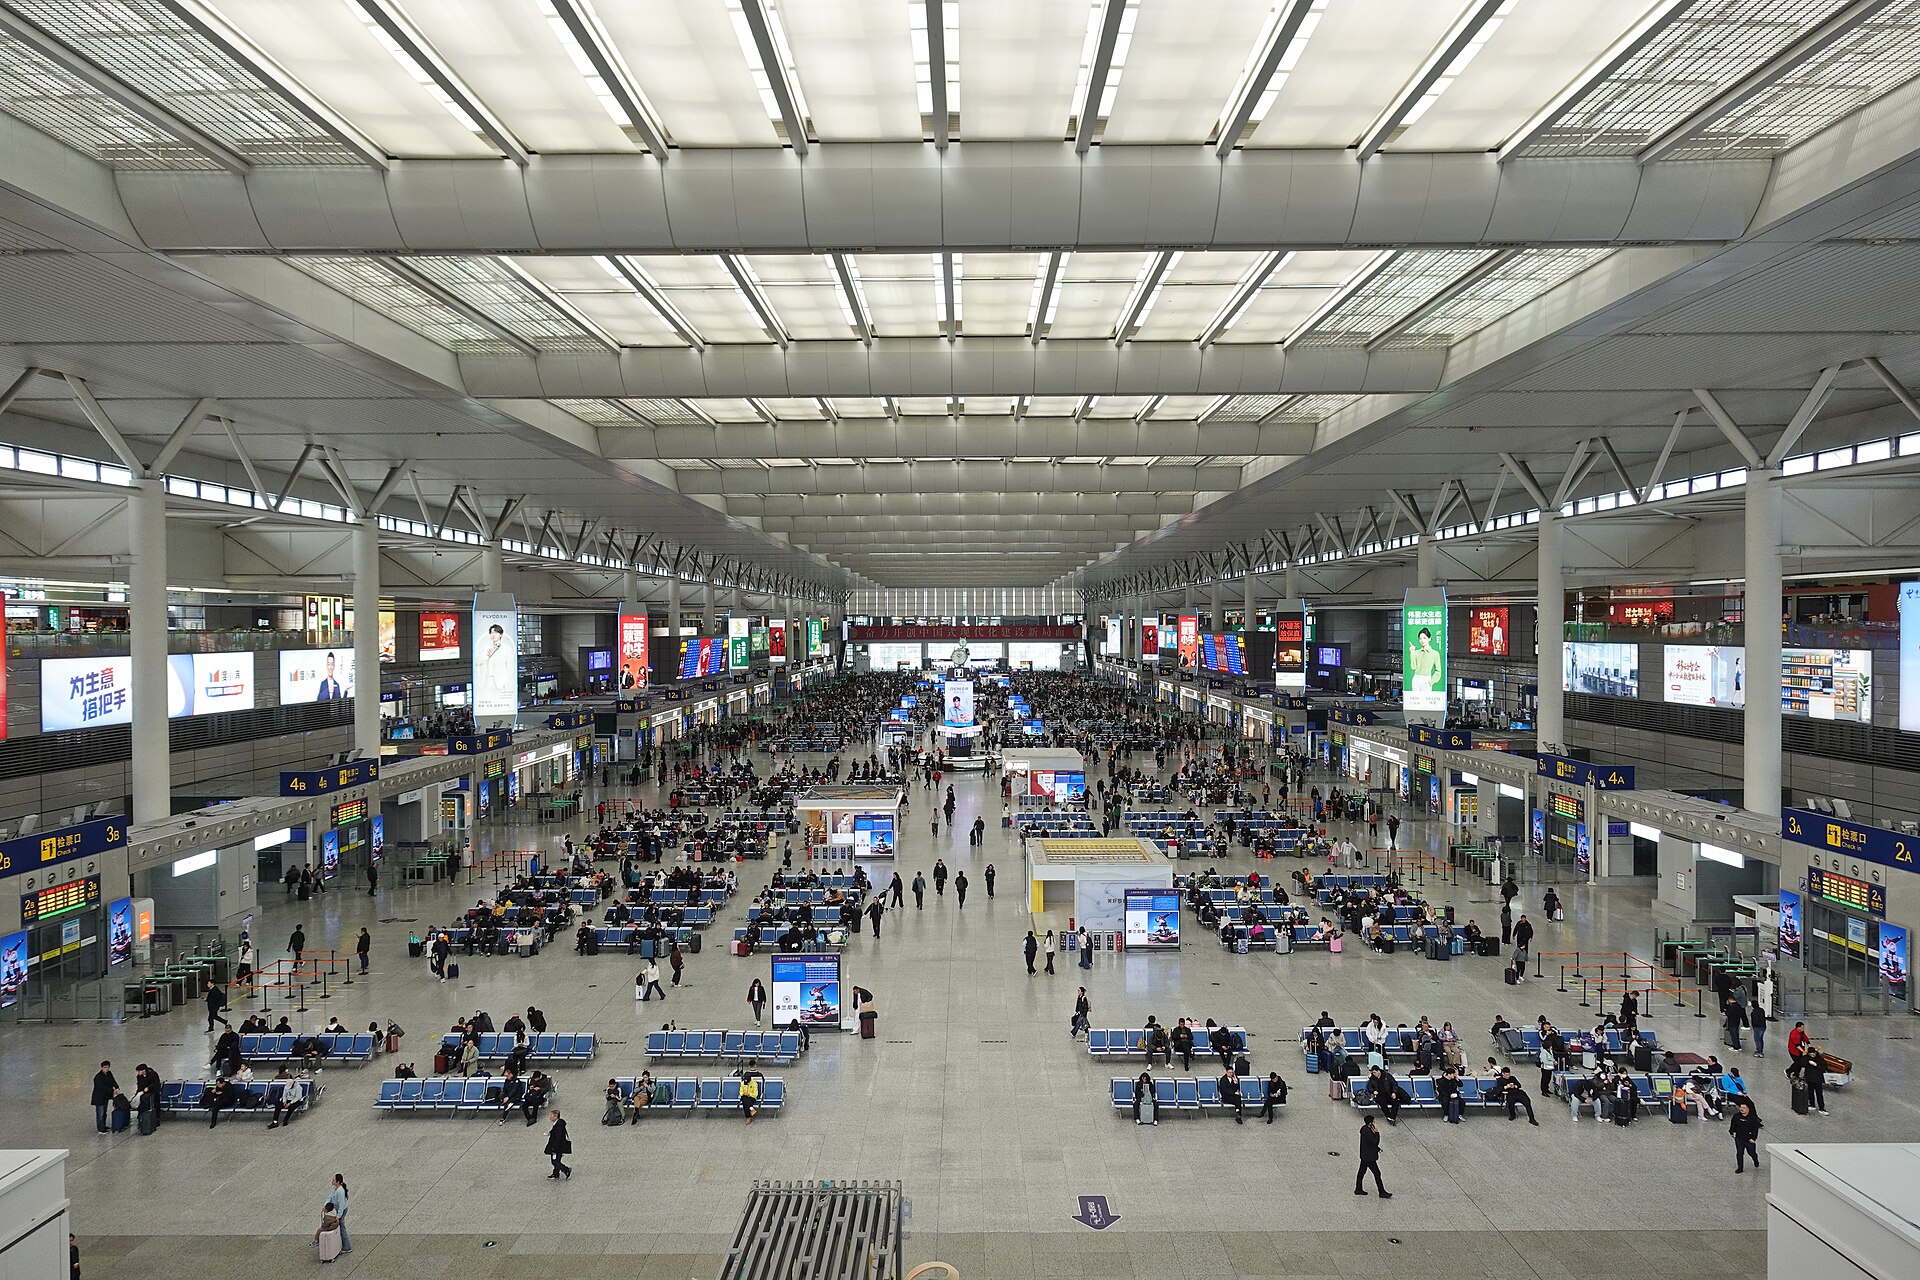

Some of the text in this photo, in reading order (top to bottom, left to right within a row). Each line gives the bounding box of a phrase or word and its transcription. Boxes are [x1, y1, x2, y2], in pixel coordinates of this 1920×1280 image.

[866, 627, 1065, 638] 奋力开创中国式现代化建设新局面
[70, 667, 114, 700] 为生意
[668, 691, 678, 699] 12B
[82, 688, 126, 722] 搭把手
[554, 718, 565, 727] 8B
[1356, 713, 1367, 723] 8A
[455, 740, 468, 751] 6B
[1451, 735, 1463, 746] 6A
[369, 764, 377, 777] 5B
[1539, 758, 1546, 772] 5A
[318, 776, 328, 789] 4B
[1587, 769, 1596, 784] 4A
[1608, 771, 1625, 785] 4A
[289, 777, 306, 791] 4B
[1788, 816, 1802, 836] 3A
[106, 825, 120, 843] 3B
[1841, 829, 1867, 844] 检票口
[57, 833, 81, 849] 检票口
[1841, 841, 1857, 850] Check
[57, 848, 71, 856] Check
[1895, 841, 1913, 863] 2A
[1811, 872, 1820, 882] 3A
[88, 881, 97, 891] 3B
[1871, 889, 1882, 902] 2A
[25, 899, 35, 911] 2B
